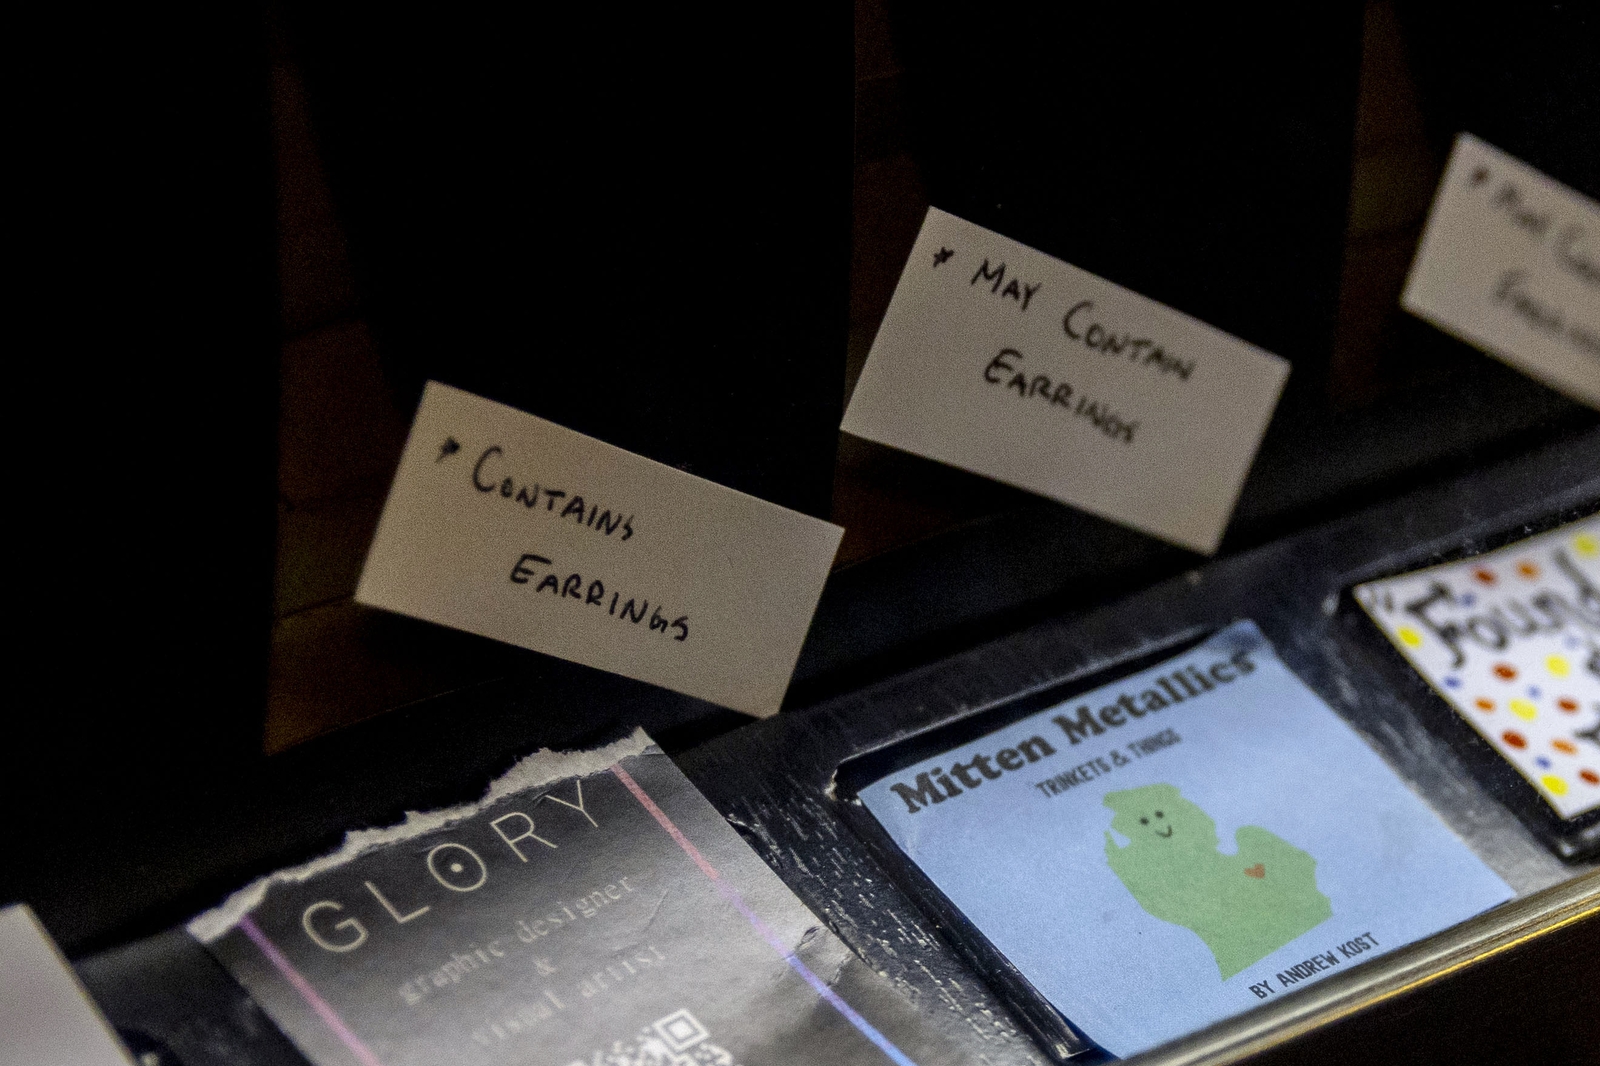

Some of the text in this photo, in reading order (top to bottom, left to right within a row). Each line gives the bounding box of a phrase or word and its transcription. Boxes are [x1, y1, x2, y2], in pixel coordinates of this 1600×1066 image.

[971, 258, 1042, 311] MAY
[472, 446, 633, 540] CONTAINS
[510, 554, 689, 641] EARRINGS
[891, 649, 1257, 813] Mitten Metallics
[1035, 728, 1182, 799] TRINKETS & THINGS
[302, 780, 598, 953] GLORY
[400, 872, 635, 1006] graphic designer
[534, 956, 557, 978] &
[1248, 931, 1381, 1000] BY ANDREW KOST
[473, 942, 668, 1044] visual artist
